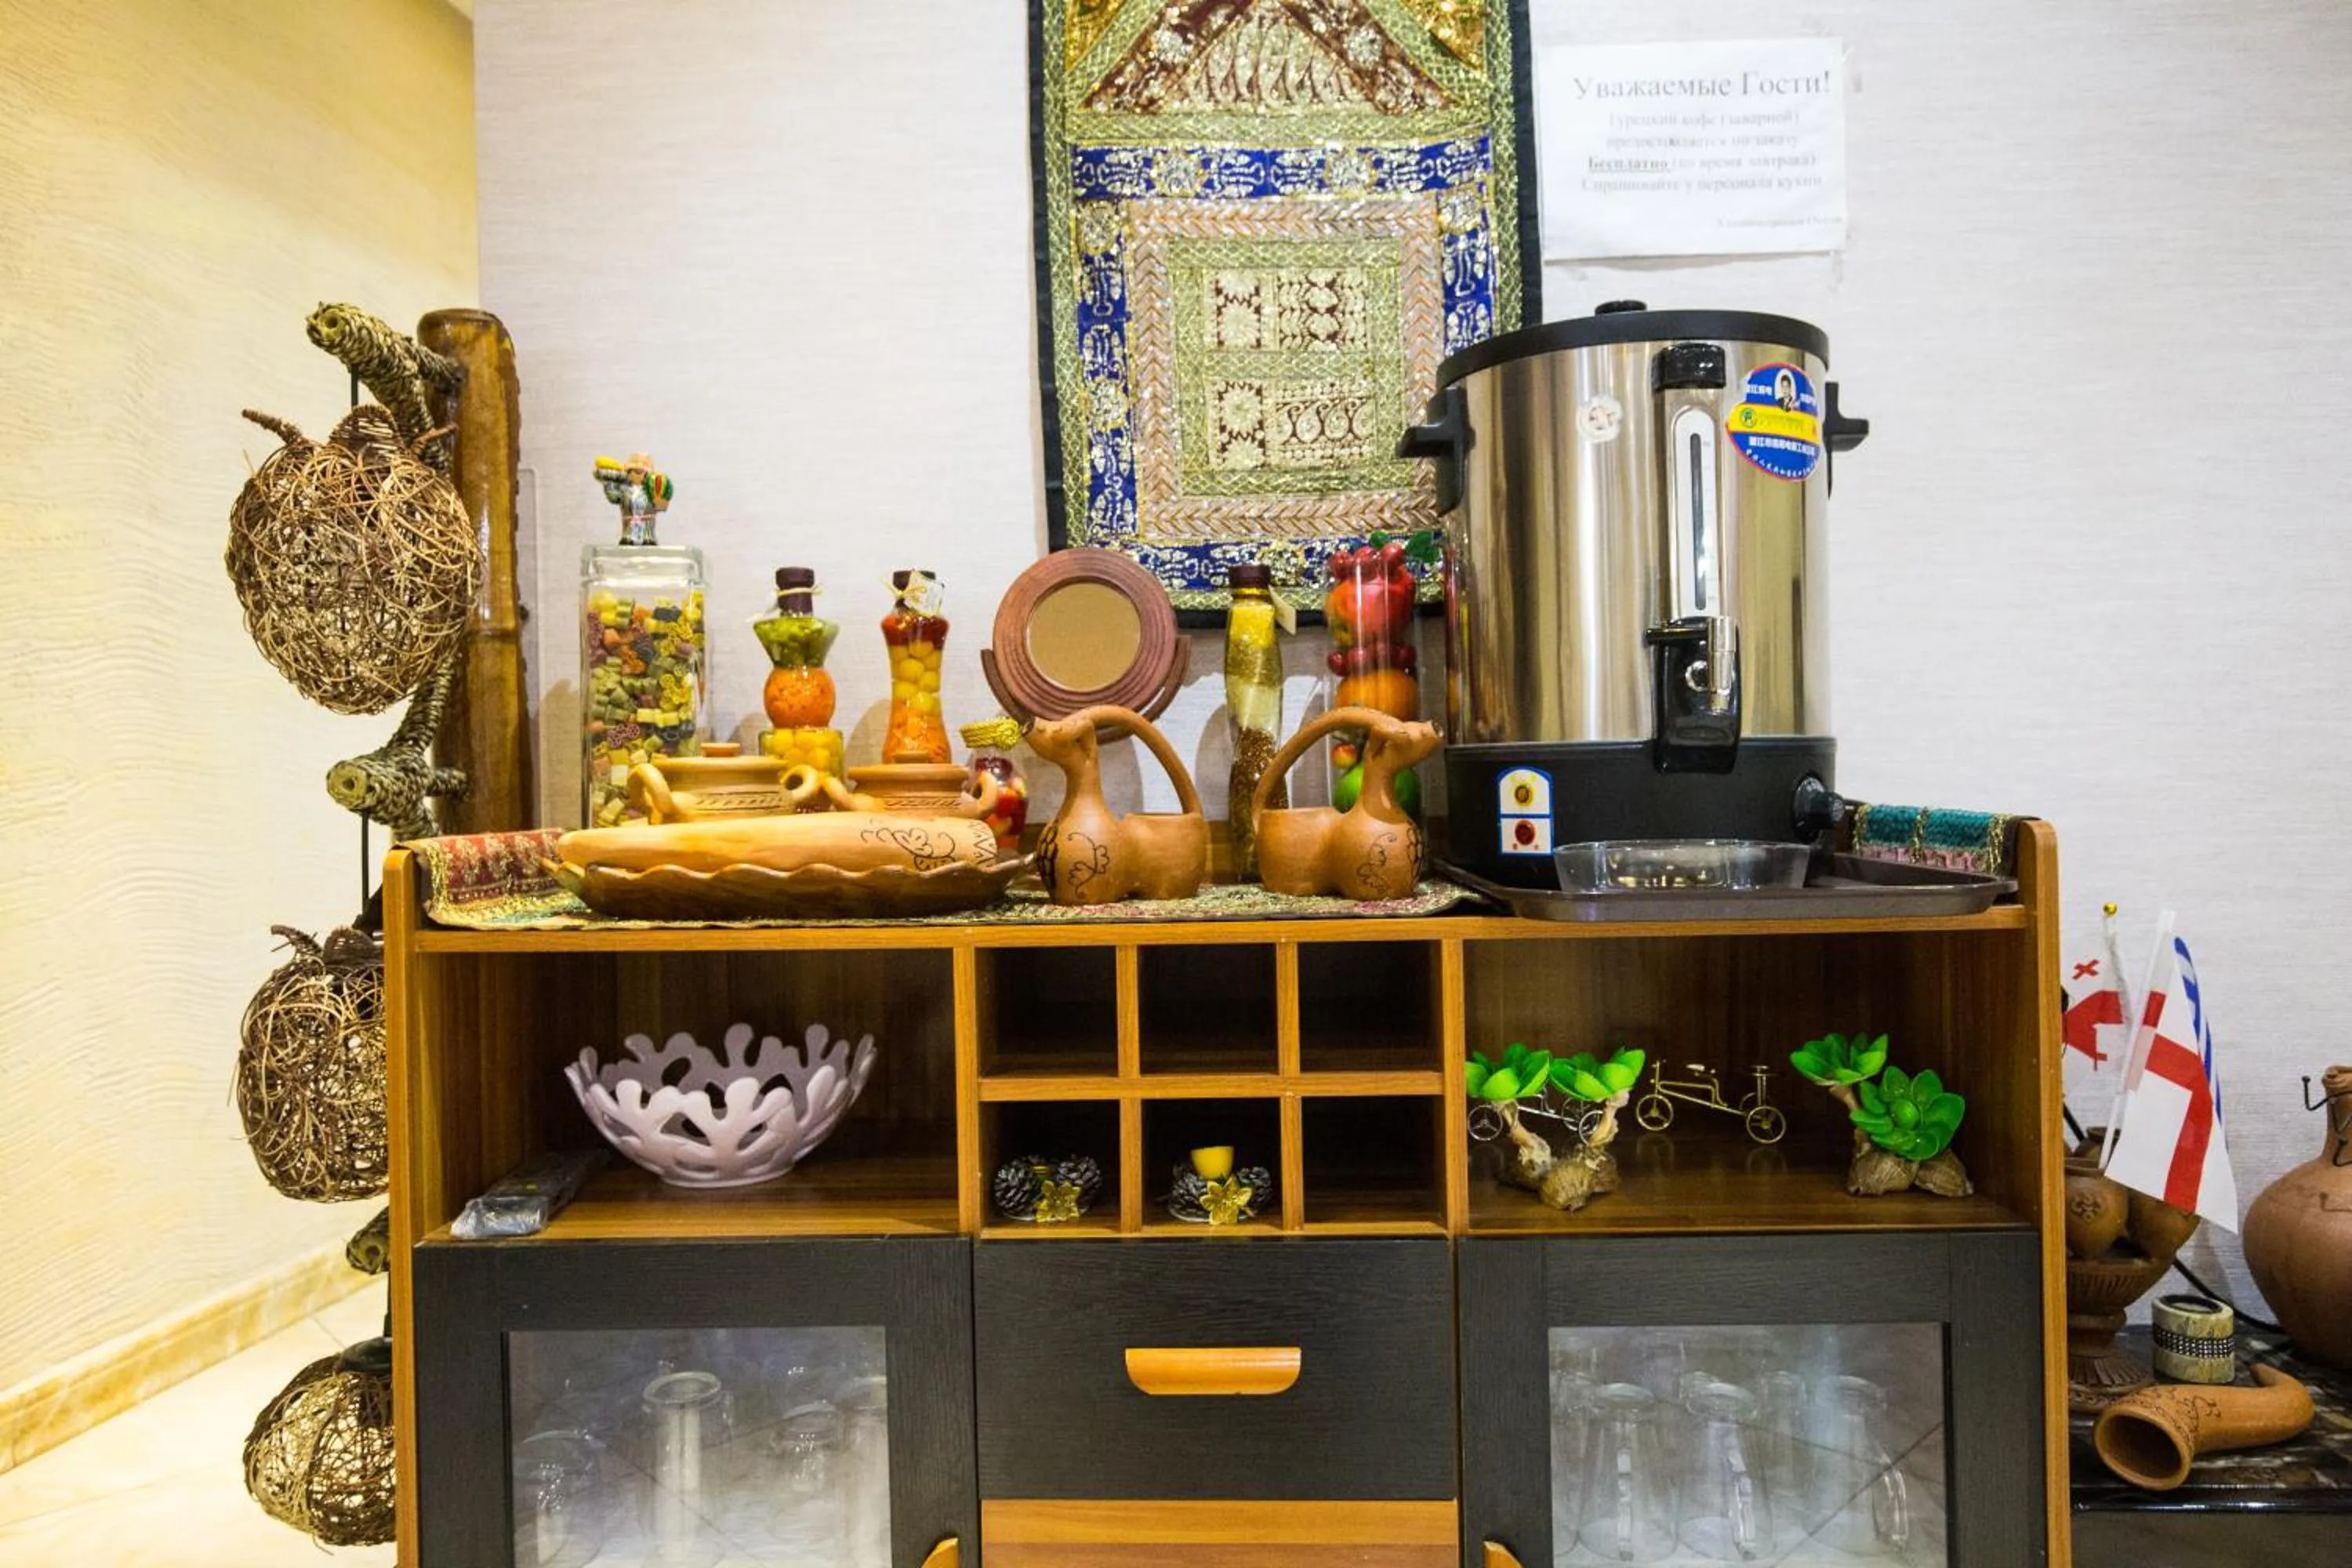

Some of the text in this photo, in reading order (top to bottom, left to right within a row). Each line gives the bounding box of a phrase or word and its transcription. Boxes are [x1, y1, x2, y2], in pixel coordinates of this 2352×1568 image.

[1573, 71, 1831, 100] Уважаемые Гости!
[1682, 113, 1716, 129] кофе
[1588, 155, 1670, 172] Бесплатно
